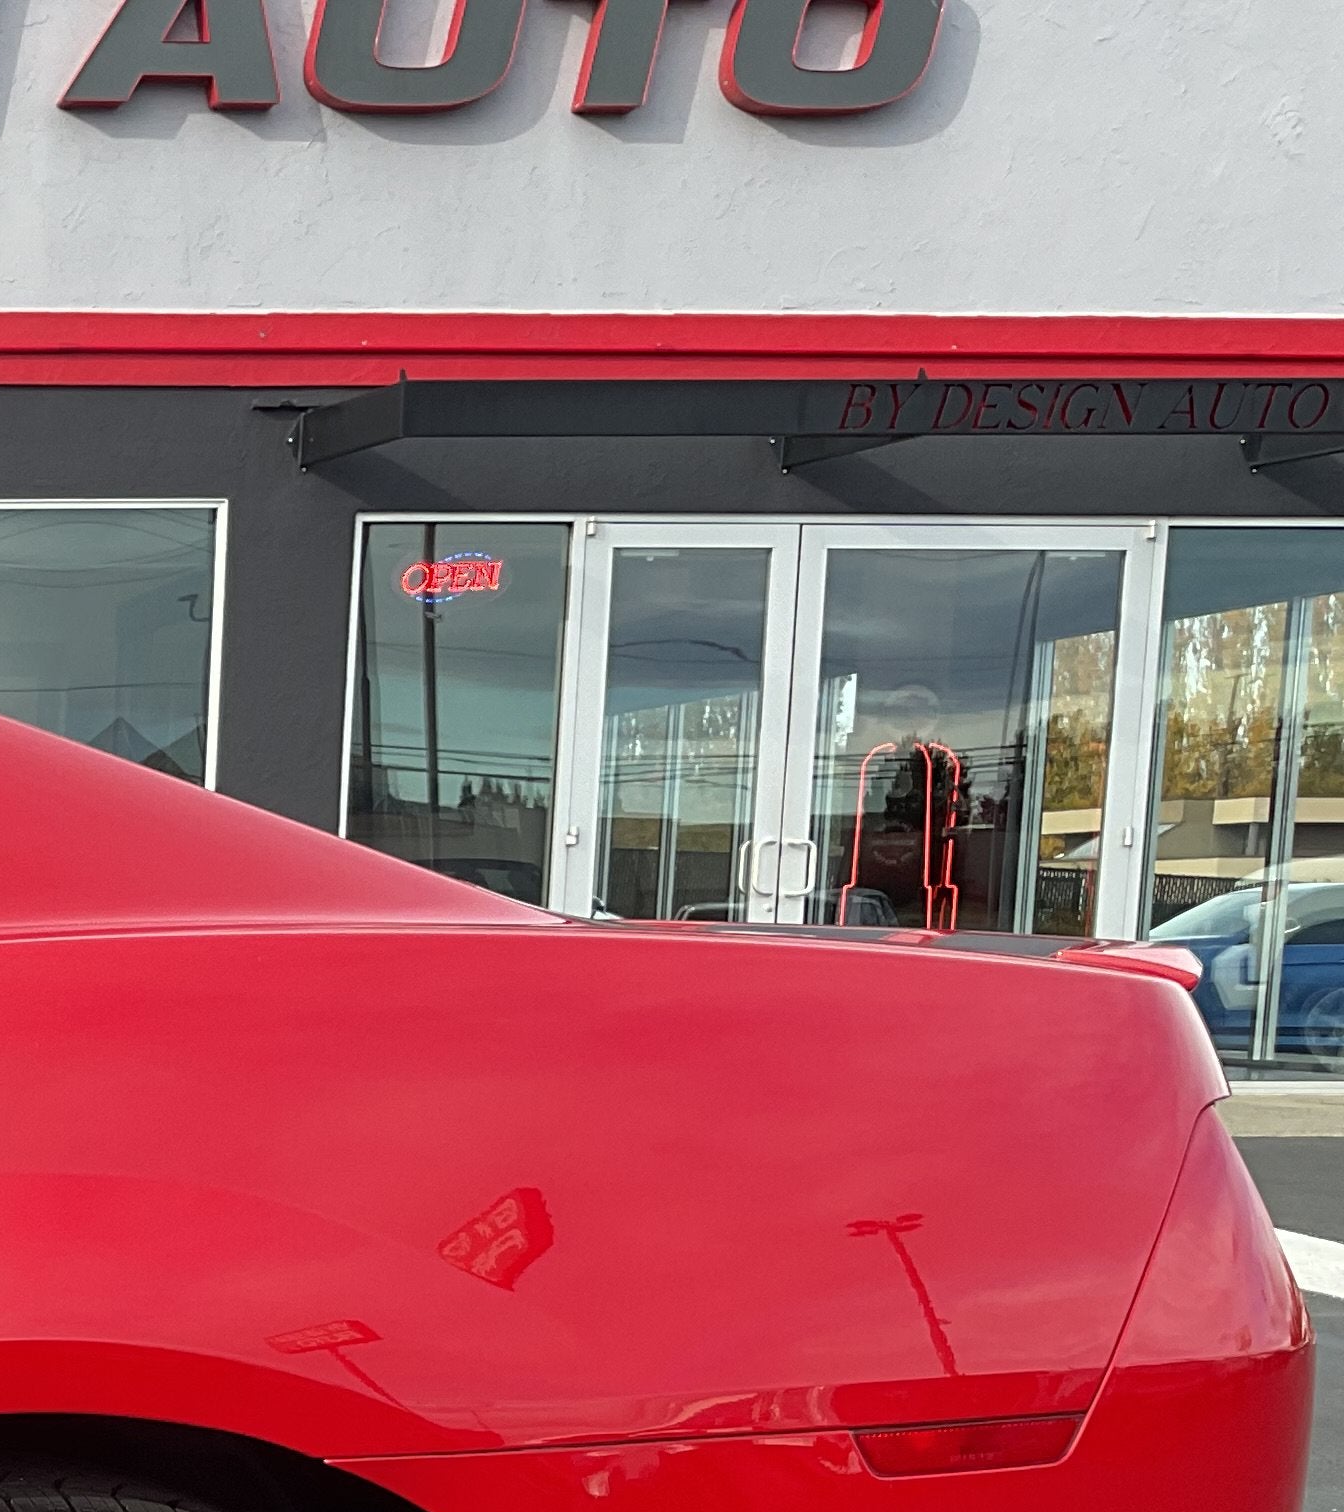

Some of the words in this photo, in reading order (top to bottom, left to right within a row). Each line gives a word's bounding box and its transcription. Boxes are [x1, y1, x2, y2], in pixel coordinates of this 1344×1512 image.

[57, 0, 944, 116] AUTO
[839, 383, 922, 431] BY
[931, 383, 1149, 431] DESIGN
[1157, 383, 1331, 430] AUTO
[401, 560, 503, 595] OPEN
